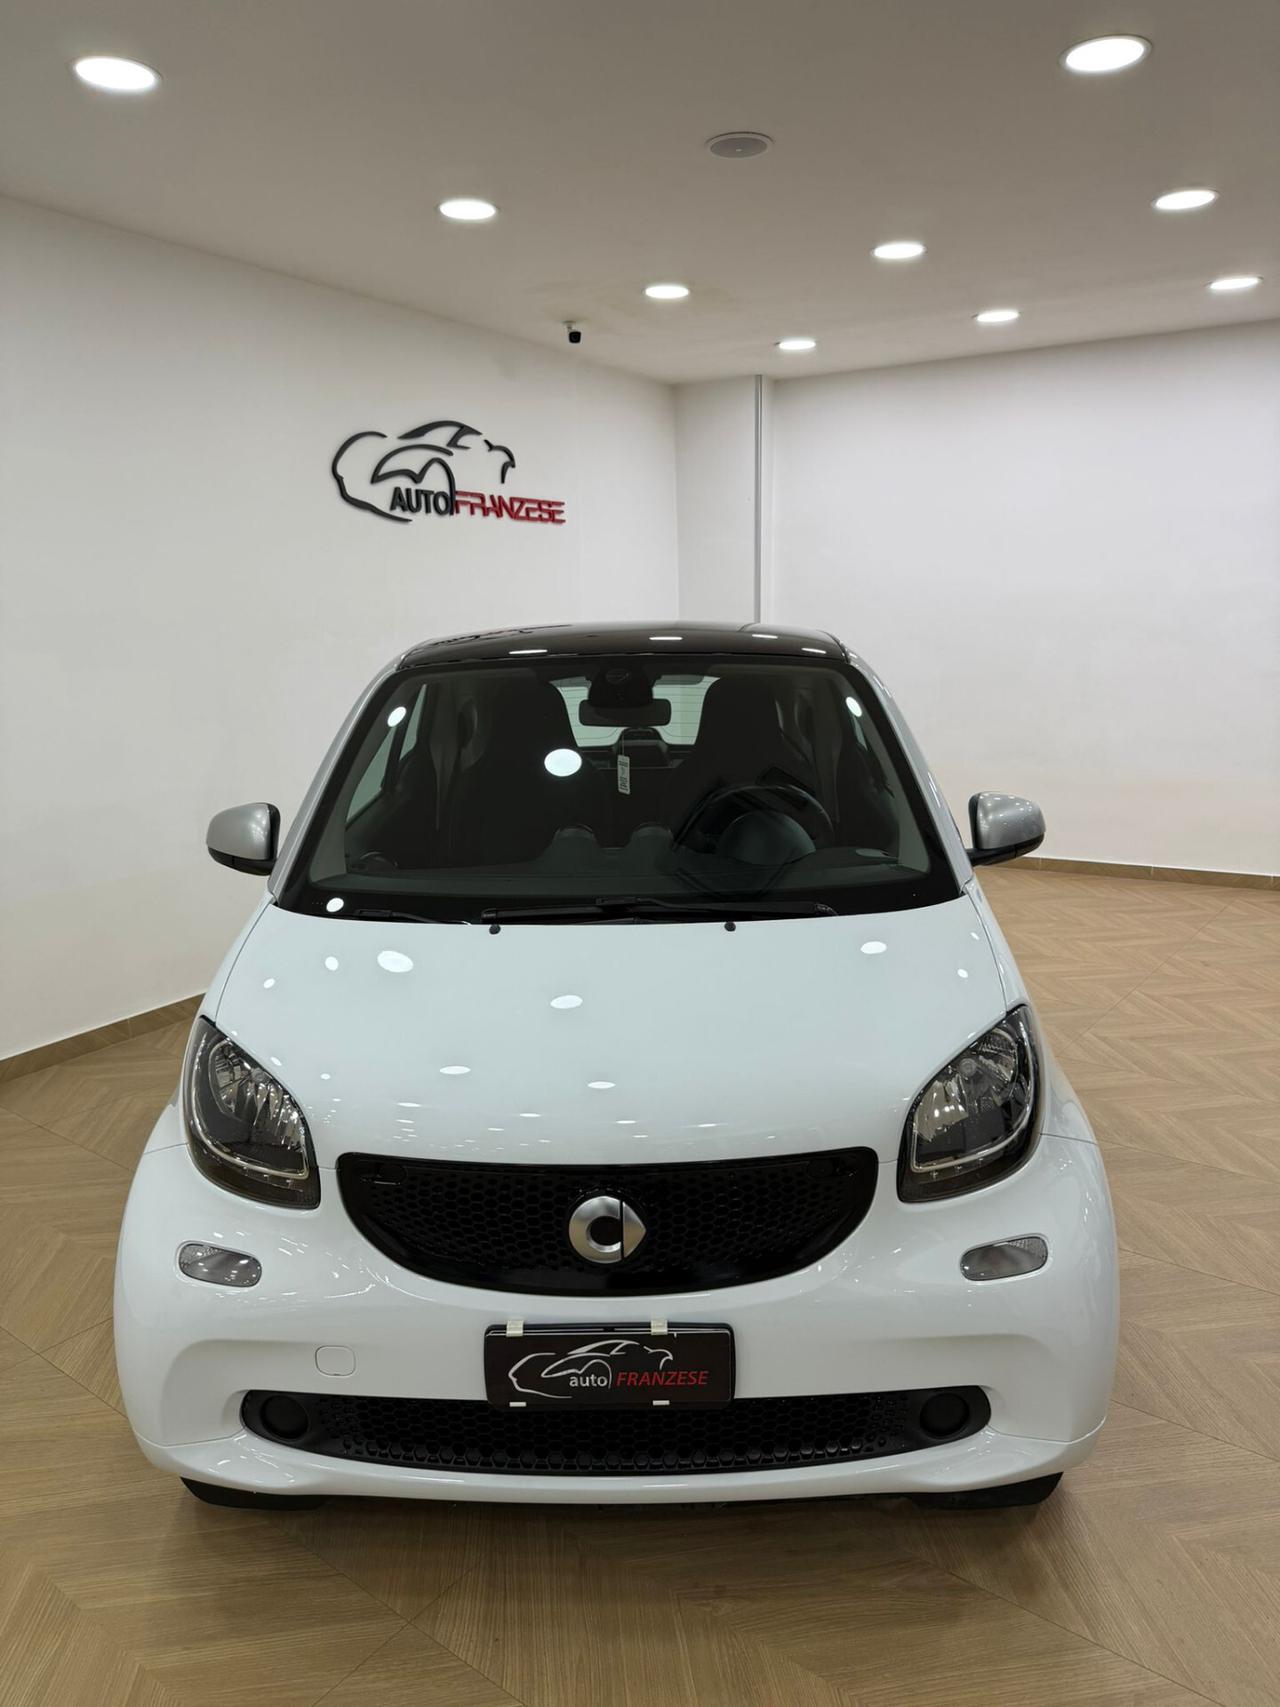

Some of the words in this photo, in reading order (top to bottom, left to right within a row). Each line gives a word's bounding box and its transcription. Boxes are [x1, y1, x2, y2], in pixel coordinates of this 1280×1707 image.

[390, 487, 450, 516] AUTO
[454, 490, 566, 524] FRANZESE
[569, 1372, 608, 1387] auto
[616, 1370, 709, 1387] FRANZESE
